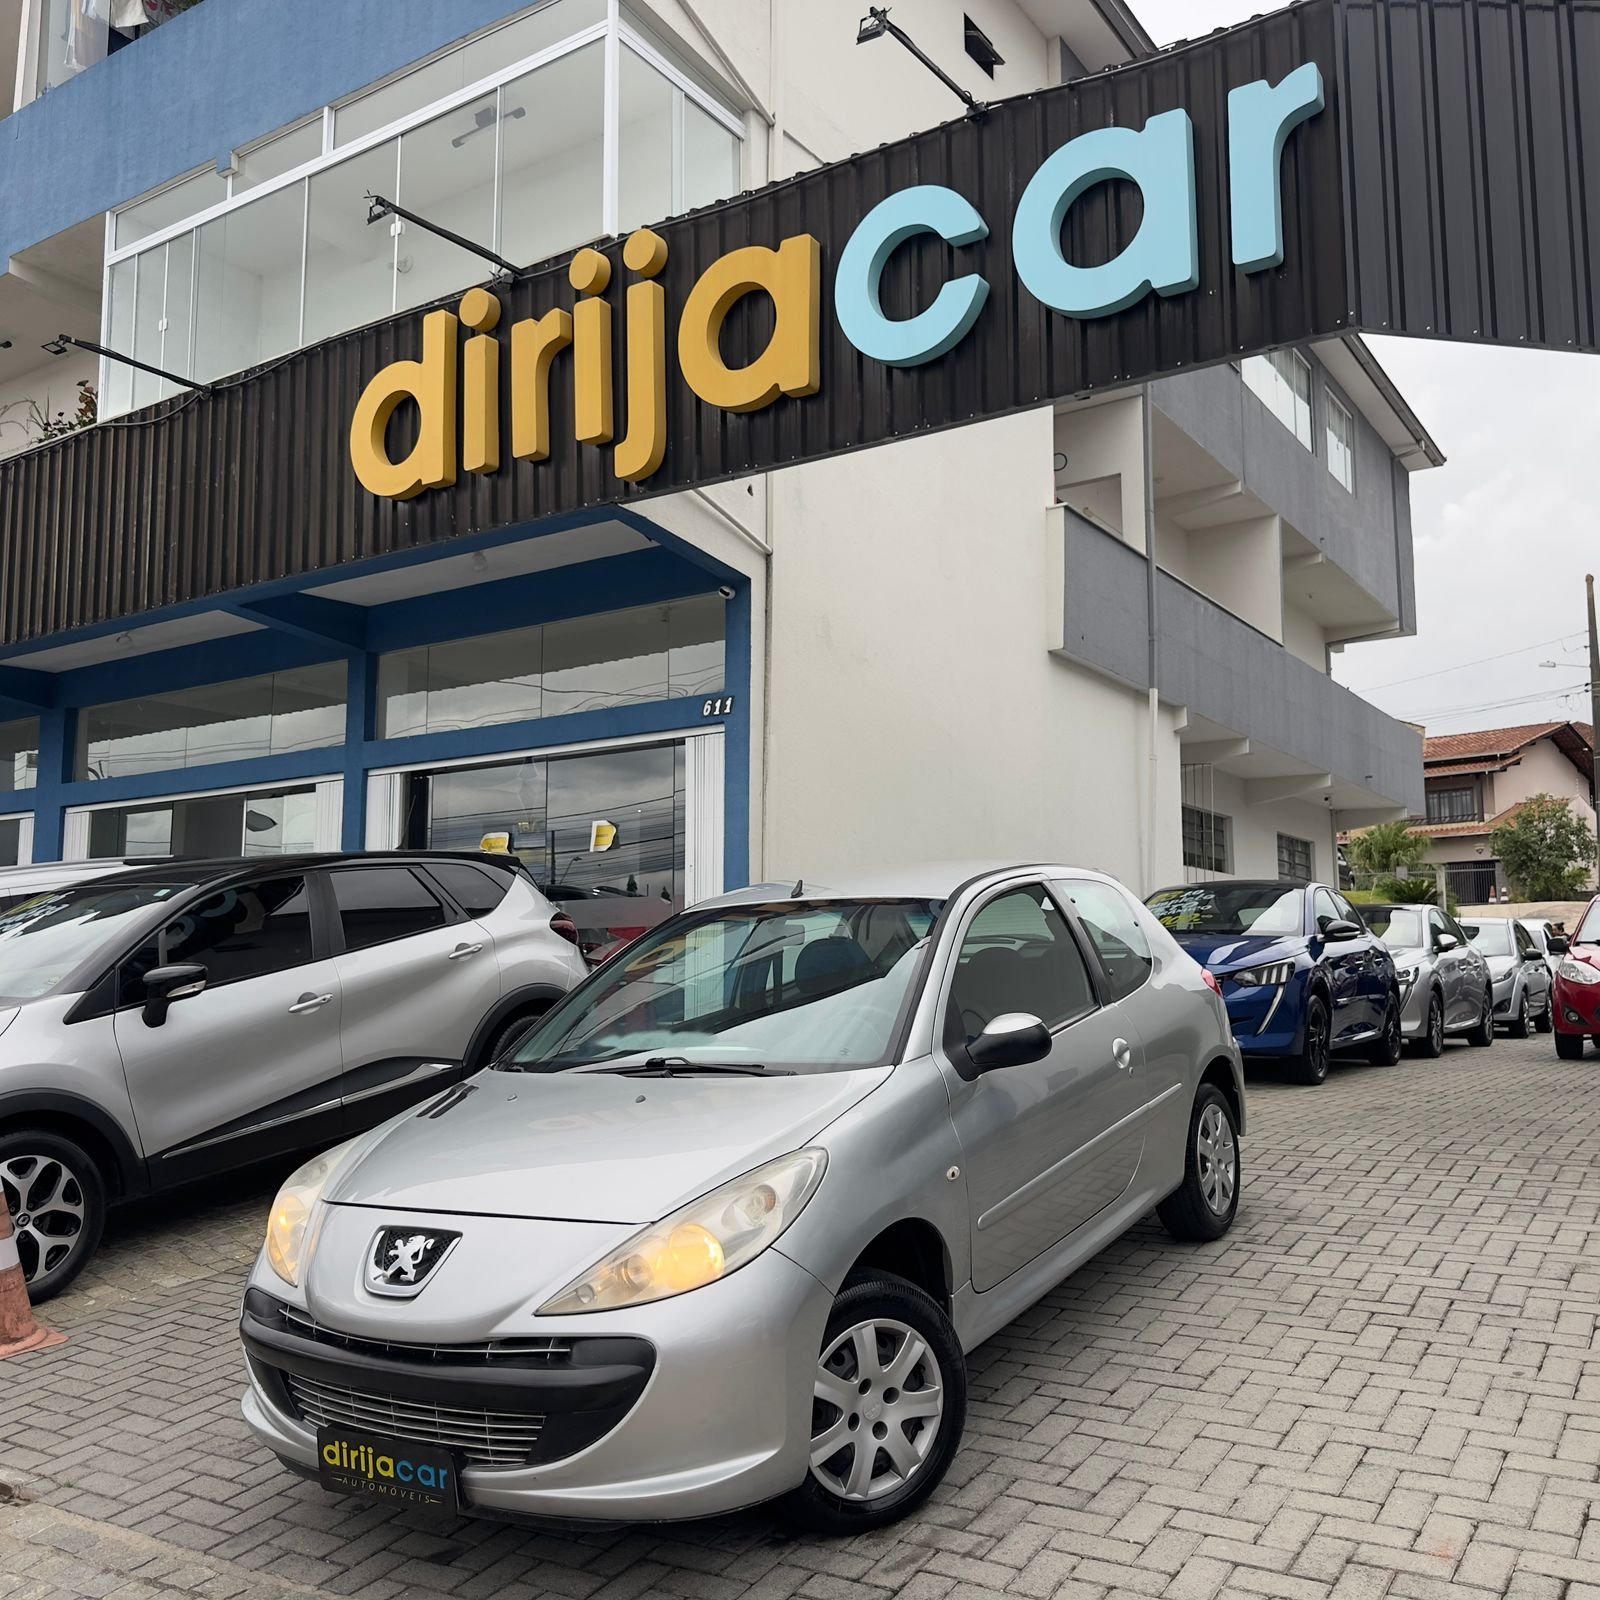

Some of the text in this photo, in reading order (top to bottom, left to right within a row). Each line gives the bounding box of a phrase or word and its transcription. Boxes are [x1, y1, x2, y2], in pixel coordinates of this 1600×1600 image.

[350, 62, 1325, 500] dirijacar
[703, 697, 732, 716] 611
[323, 1440, 448, 1489] dirijacar
